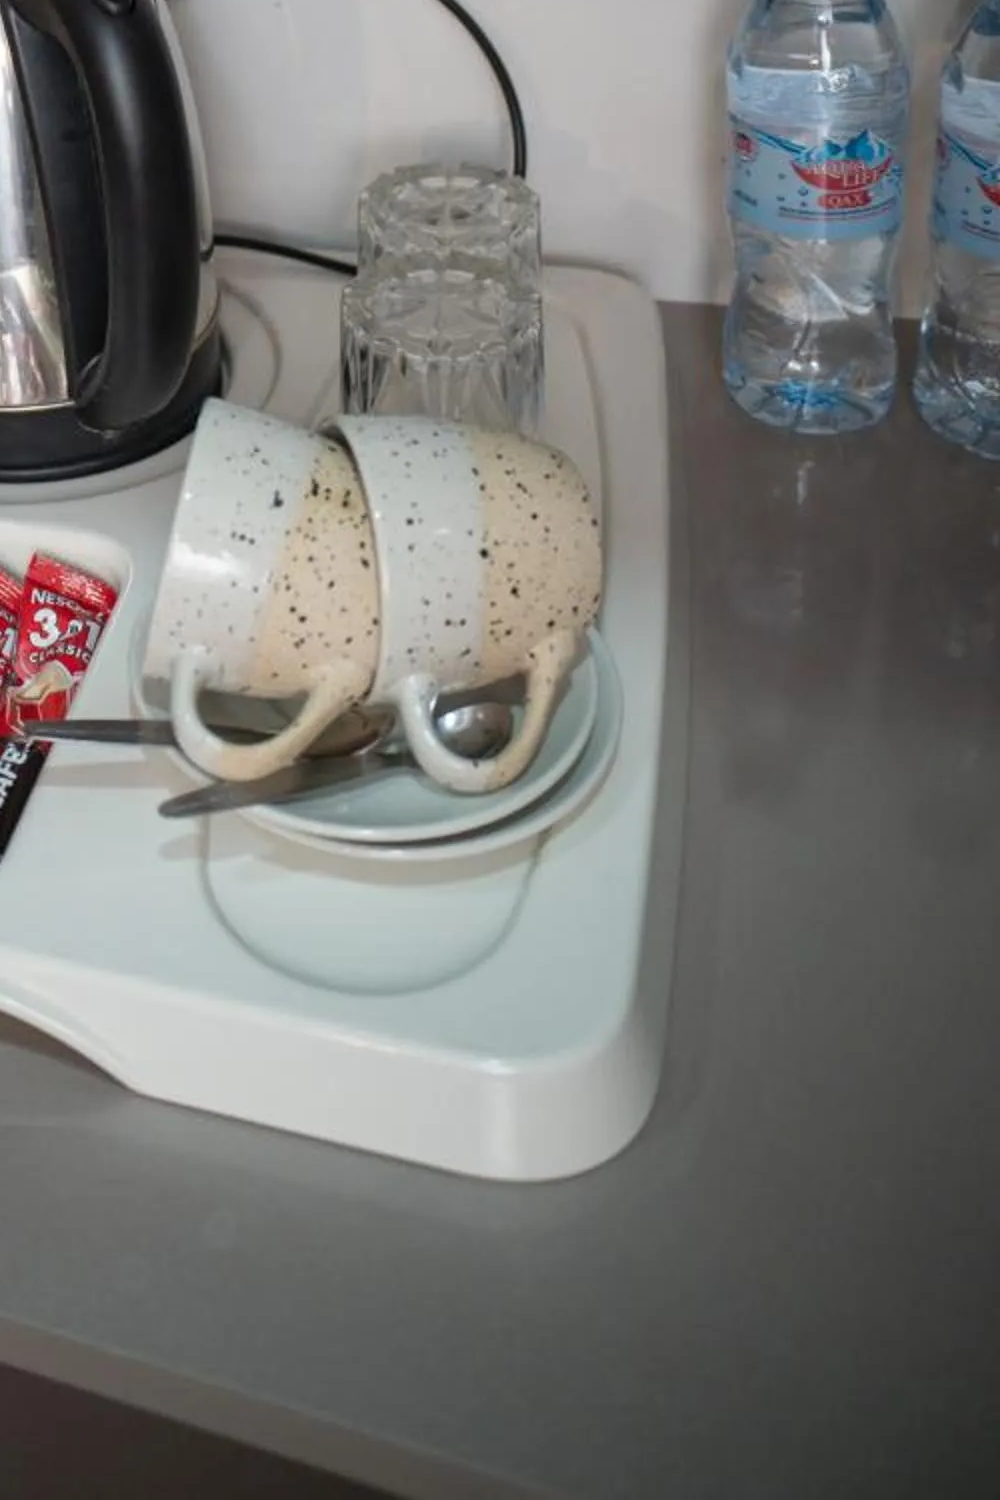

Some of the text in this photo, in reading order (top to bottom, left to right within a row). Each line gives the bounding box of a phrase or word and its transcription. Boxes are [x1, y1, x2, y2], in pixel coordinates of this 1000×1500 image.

[1, 627, 17, 658] 1
[29, 608, 61, 647] 3
[29, 644, 92, 663] CLASSIC
